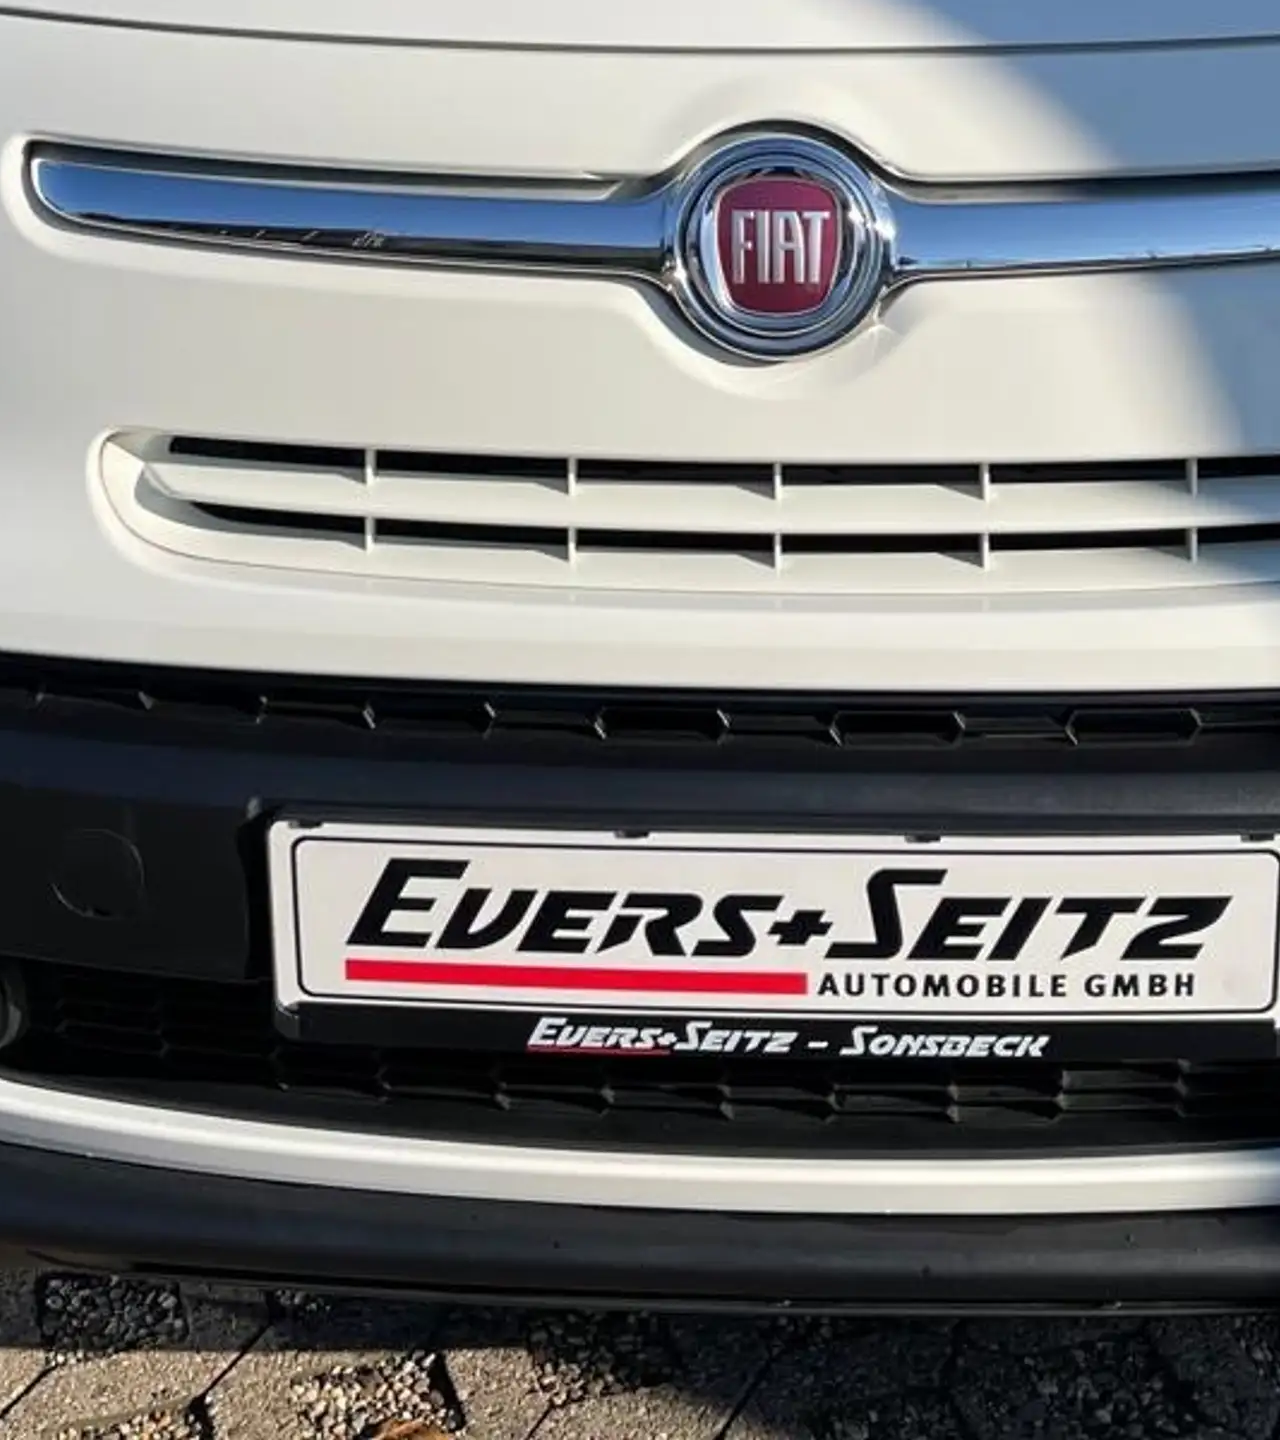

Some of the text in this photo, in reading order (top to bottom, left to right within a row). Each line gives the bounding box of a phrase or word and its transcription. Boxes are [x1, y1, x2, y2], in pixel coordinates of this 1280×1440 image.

[730, 209, 830, 285] FIAT
[345, 858, 1233, 961] EVERS+SEITZ
[817, 968, 1197, 999] AUTOMOBILE GMBH
[525, 1016, 794, 1054] EVERS+SEITZ
[839, 1024, 1049, 1058] SONSBECK
